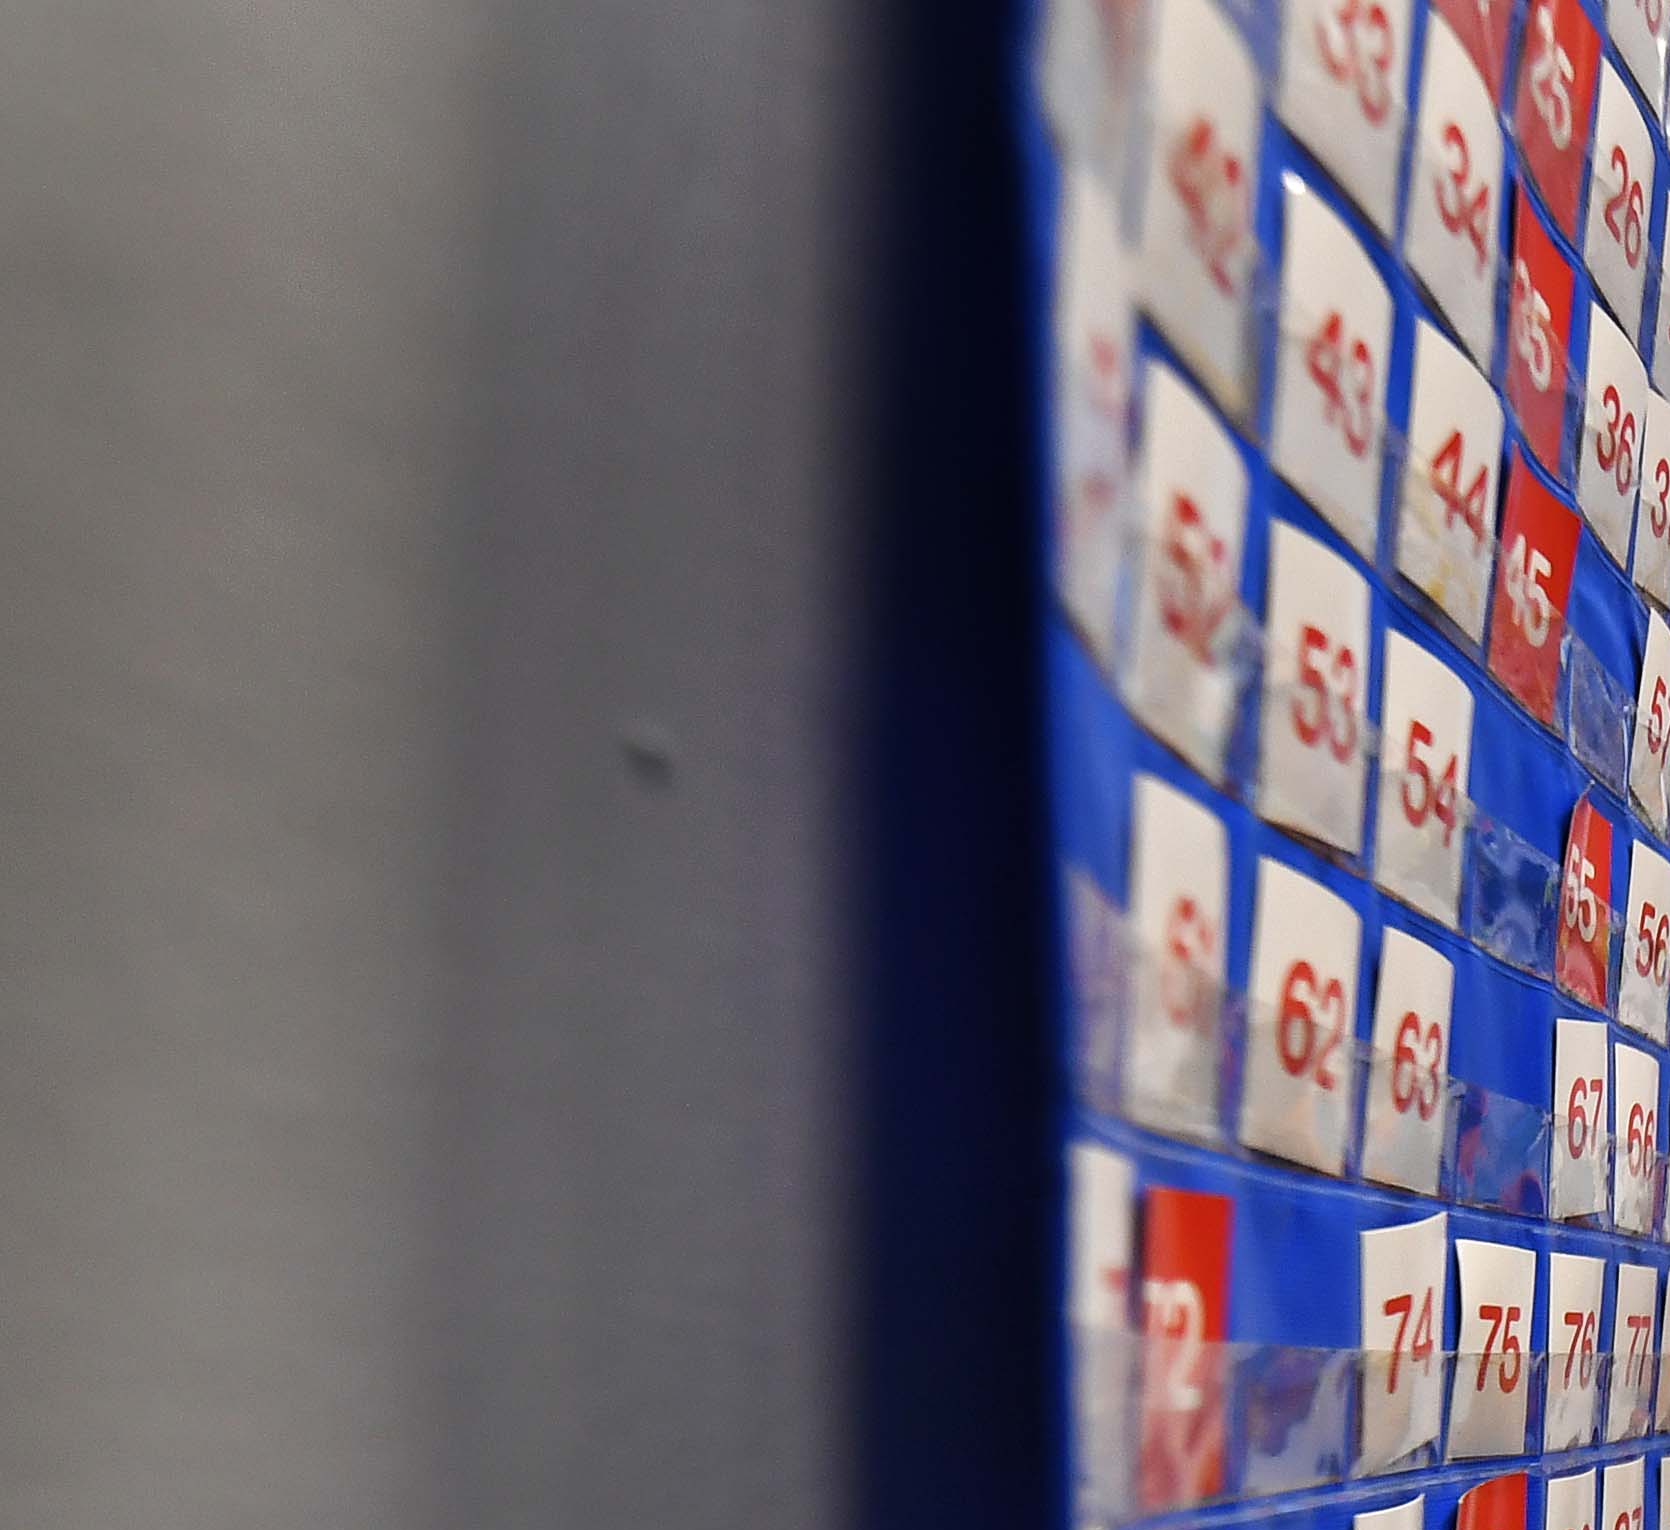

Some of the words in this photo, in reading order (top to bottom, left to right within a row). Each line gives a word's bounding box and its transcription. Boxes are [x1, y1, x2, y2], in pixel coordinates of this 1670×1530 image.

[1531, 4, 1576, 150] 25
[1434, 122, 1490, 277] 34
[1604, 145, 1644, 269] 26
[1306, 310, 1376, 458] 43
[1429, 430, 1488, 552] 44
[1597, 385, 1635, 496] 36
[1505, 534, 1552, 648] 45
[1291, 625, 1356, 764] 53
[1403, 719, 1459, 847] 54
[1635, 901, 1670, 987] 56
[1276, 960, 1346, 1091] 62
[1391, 1011, 1442, 1121] 63
[1567, 1077, 1603, 1159] 67
[1627, 1103, 1655, 1179] 66
[1384, 1286, 1433, 1393] 74
[1479, 1305, 1521, 1393] 75
[1564, 1310, 1595, 1390] 76
[1626, 1315, 1651, 1387] 77
